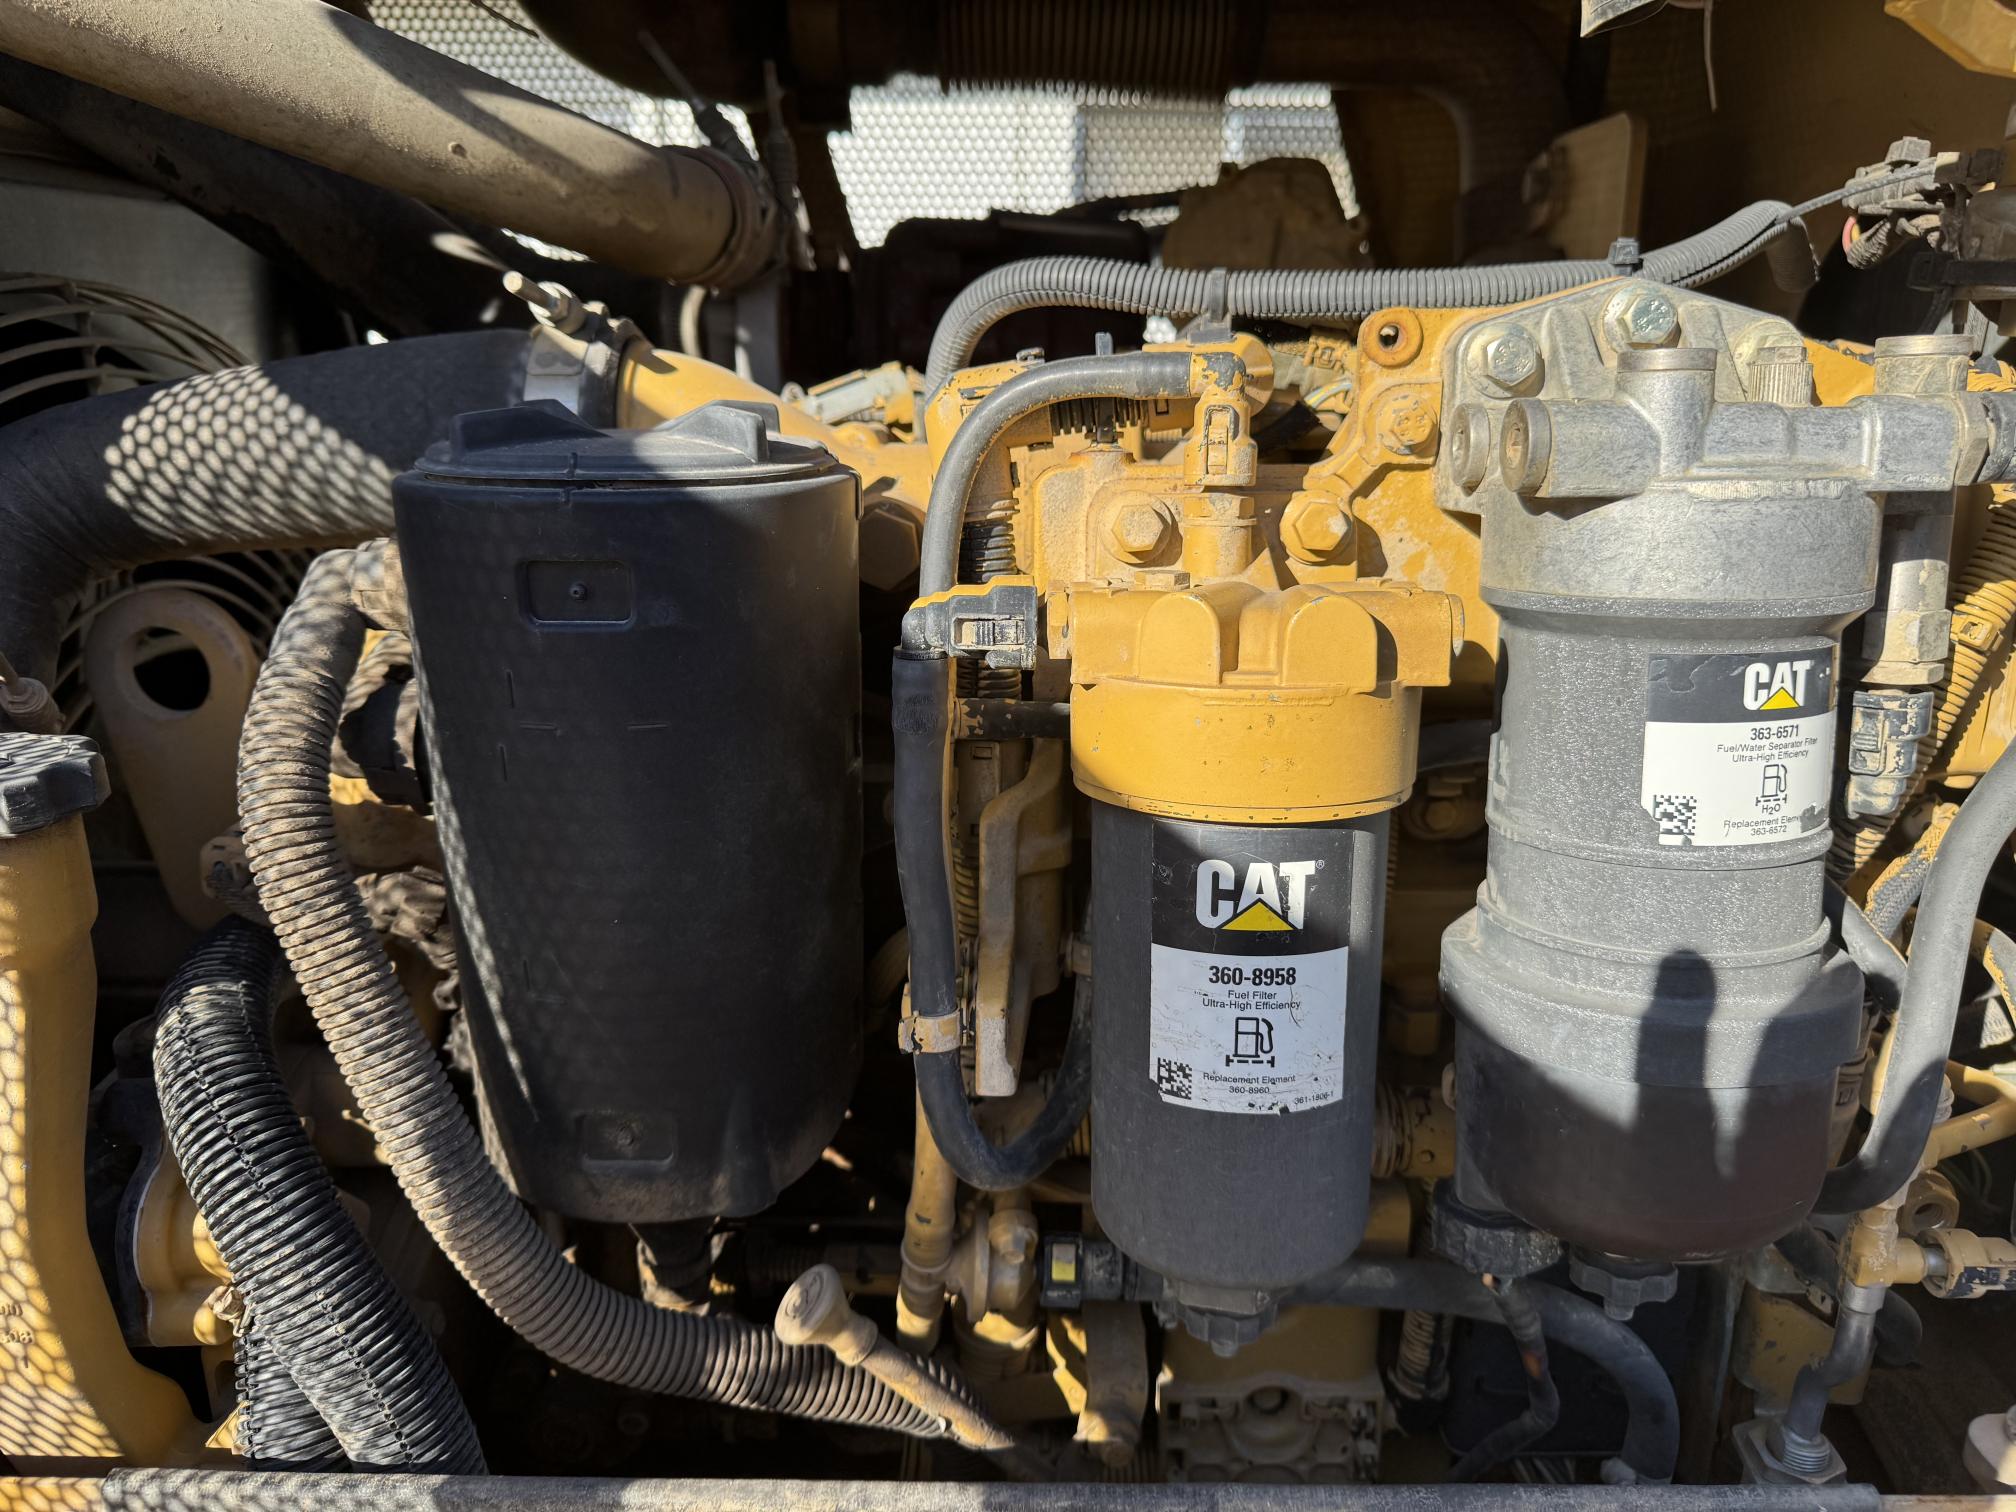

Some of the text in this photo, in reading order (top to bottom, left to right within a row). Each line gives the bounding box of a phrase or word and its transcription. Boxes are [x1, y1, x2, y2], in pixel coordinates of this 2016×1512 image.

[1742, 660, 1811, 711] CAT
[1750, 725, 1799, 740] 363-6571
[1717, 743, 1765, 753] Fuel/Water
[1768, 740, 1803, 751] Separator
[1732, 749, 1809, 763] Ultra-High Efficiency
[1761, 803, 1781, 815] H2O
[1723, 815, 1799, 830] Replacement Elem
[1751, 825, 1787, 836] 363-6572
[1195, 859, 1316, 930] CAT
[1208, 965, 1297, 986] 360-8958
[1228, 989, 1278, 1000] Fuel Filter
[1202, 997, 1301, 1011] Ultra-High Efficiency
[1203, 1072, 1297, 1085] Replacement Element
[1228, 1085, 1270, 1094] 360-8960
